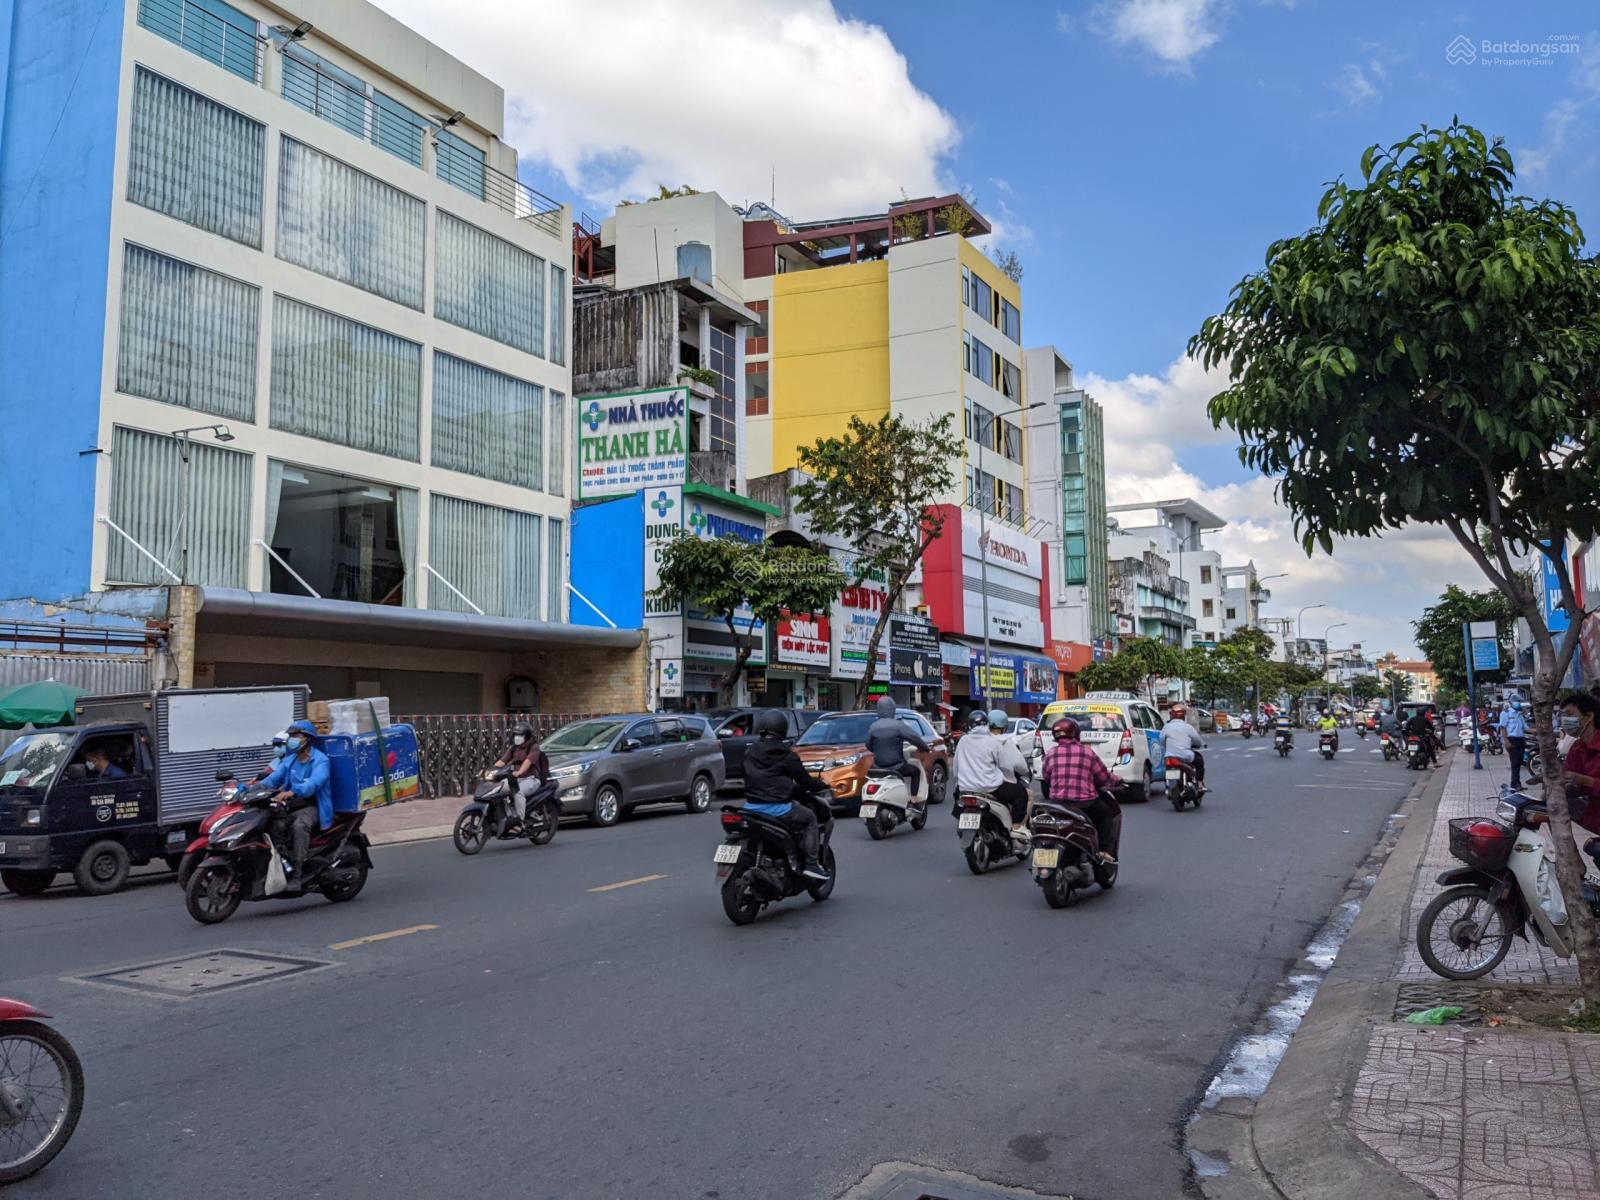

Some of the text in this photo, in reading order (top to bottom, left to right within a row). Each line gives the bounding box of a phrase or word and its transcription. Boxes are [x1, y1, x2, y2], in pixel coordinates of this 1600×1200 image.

[608, 391, 685, 425] NHÀ THUỐC
[581, 420, 685, 463] THANH HÀ
[989, 538, 1029, 567] HONDA
[927, 665, 941, 676] iPod
[1063, 704, 1088, 712] MPE
